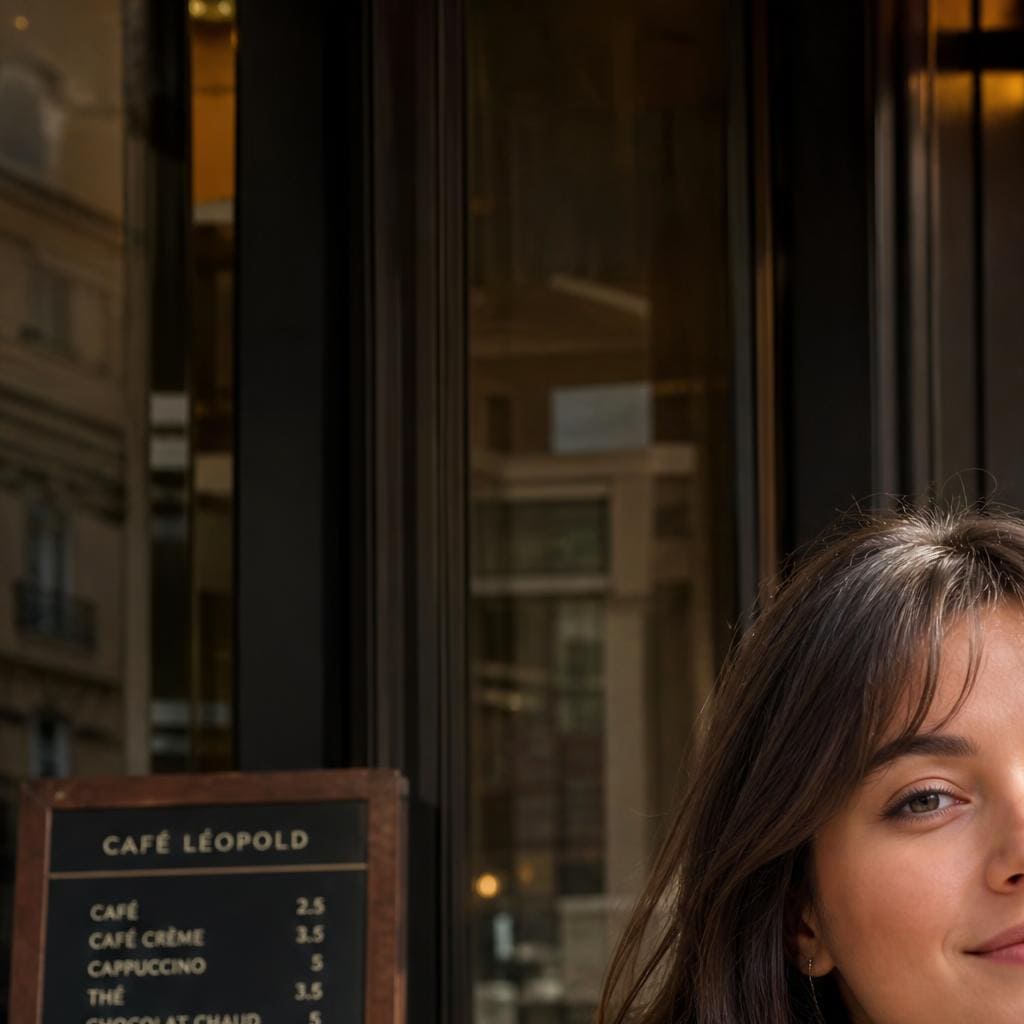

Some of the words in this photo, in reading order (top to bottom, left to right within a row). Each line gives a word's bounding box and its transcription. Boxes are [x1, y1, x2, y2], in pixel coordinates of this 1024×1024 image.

[102, 829, 170, 856] CAFÉ
[183, 828, 309, 854] LÉOPOLD
[89, 898, 138, 922] CAFÉ
[296, 896, 326, 916] 2.5
[88, 927, 136, 950] CAFÉ
[141, 925, 204, 949] CRÈME
[295, 924, 325, 944] 3.5
[87, 956, 207, 978] CAPPUCCINO
[310, 953, 324, 972] 5
[87, 984, 125, 1007] THÉ
[294, 981, 324, 1001] 3.5
